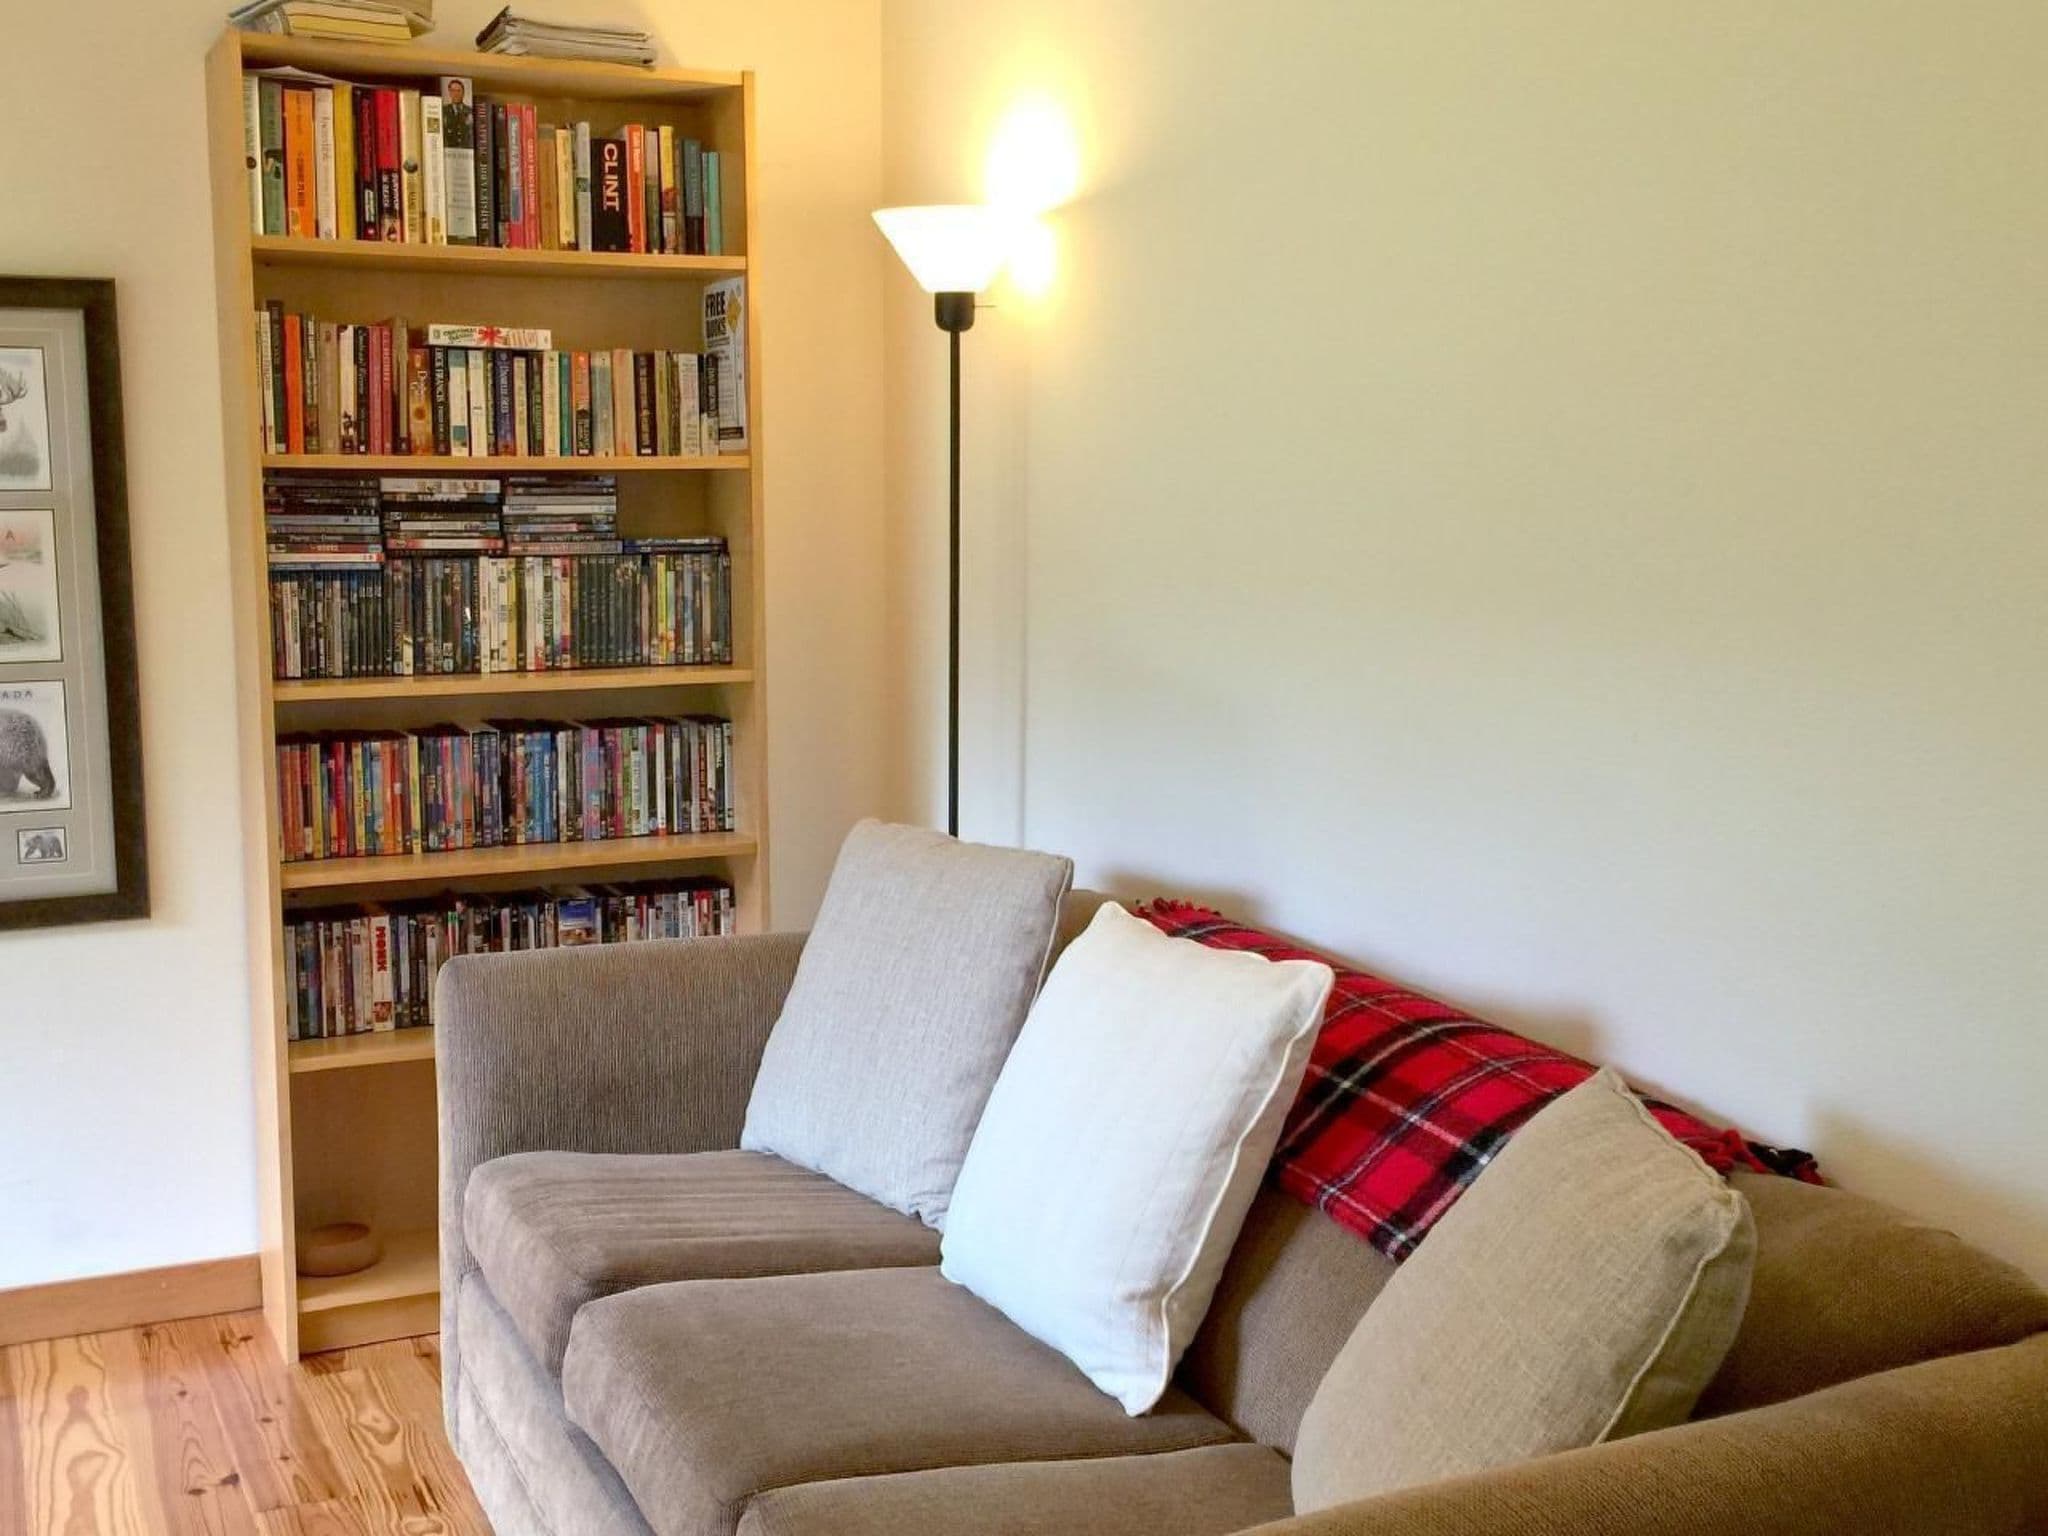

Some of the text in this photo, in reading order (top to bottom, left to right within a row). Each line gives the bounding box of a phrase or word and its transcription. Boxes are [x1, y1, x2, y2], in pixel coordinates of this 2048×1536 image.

[604, 143, 620, 212] CLINT
[705, 291, 726, 317] FREE
[435, 368, 445, 403] FRANCIS
[375, 926, 388, 973] MONK
